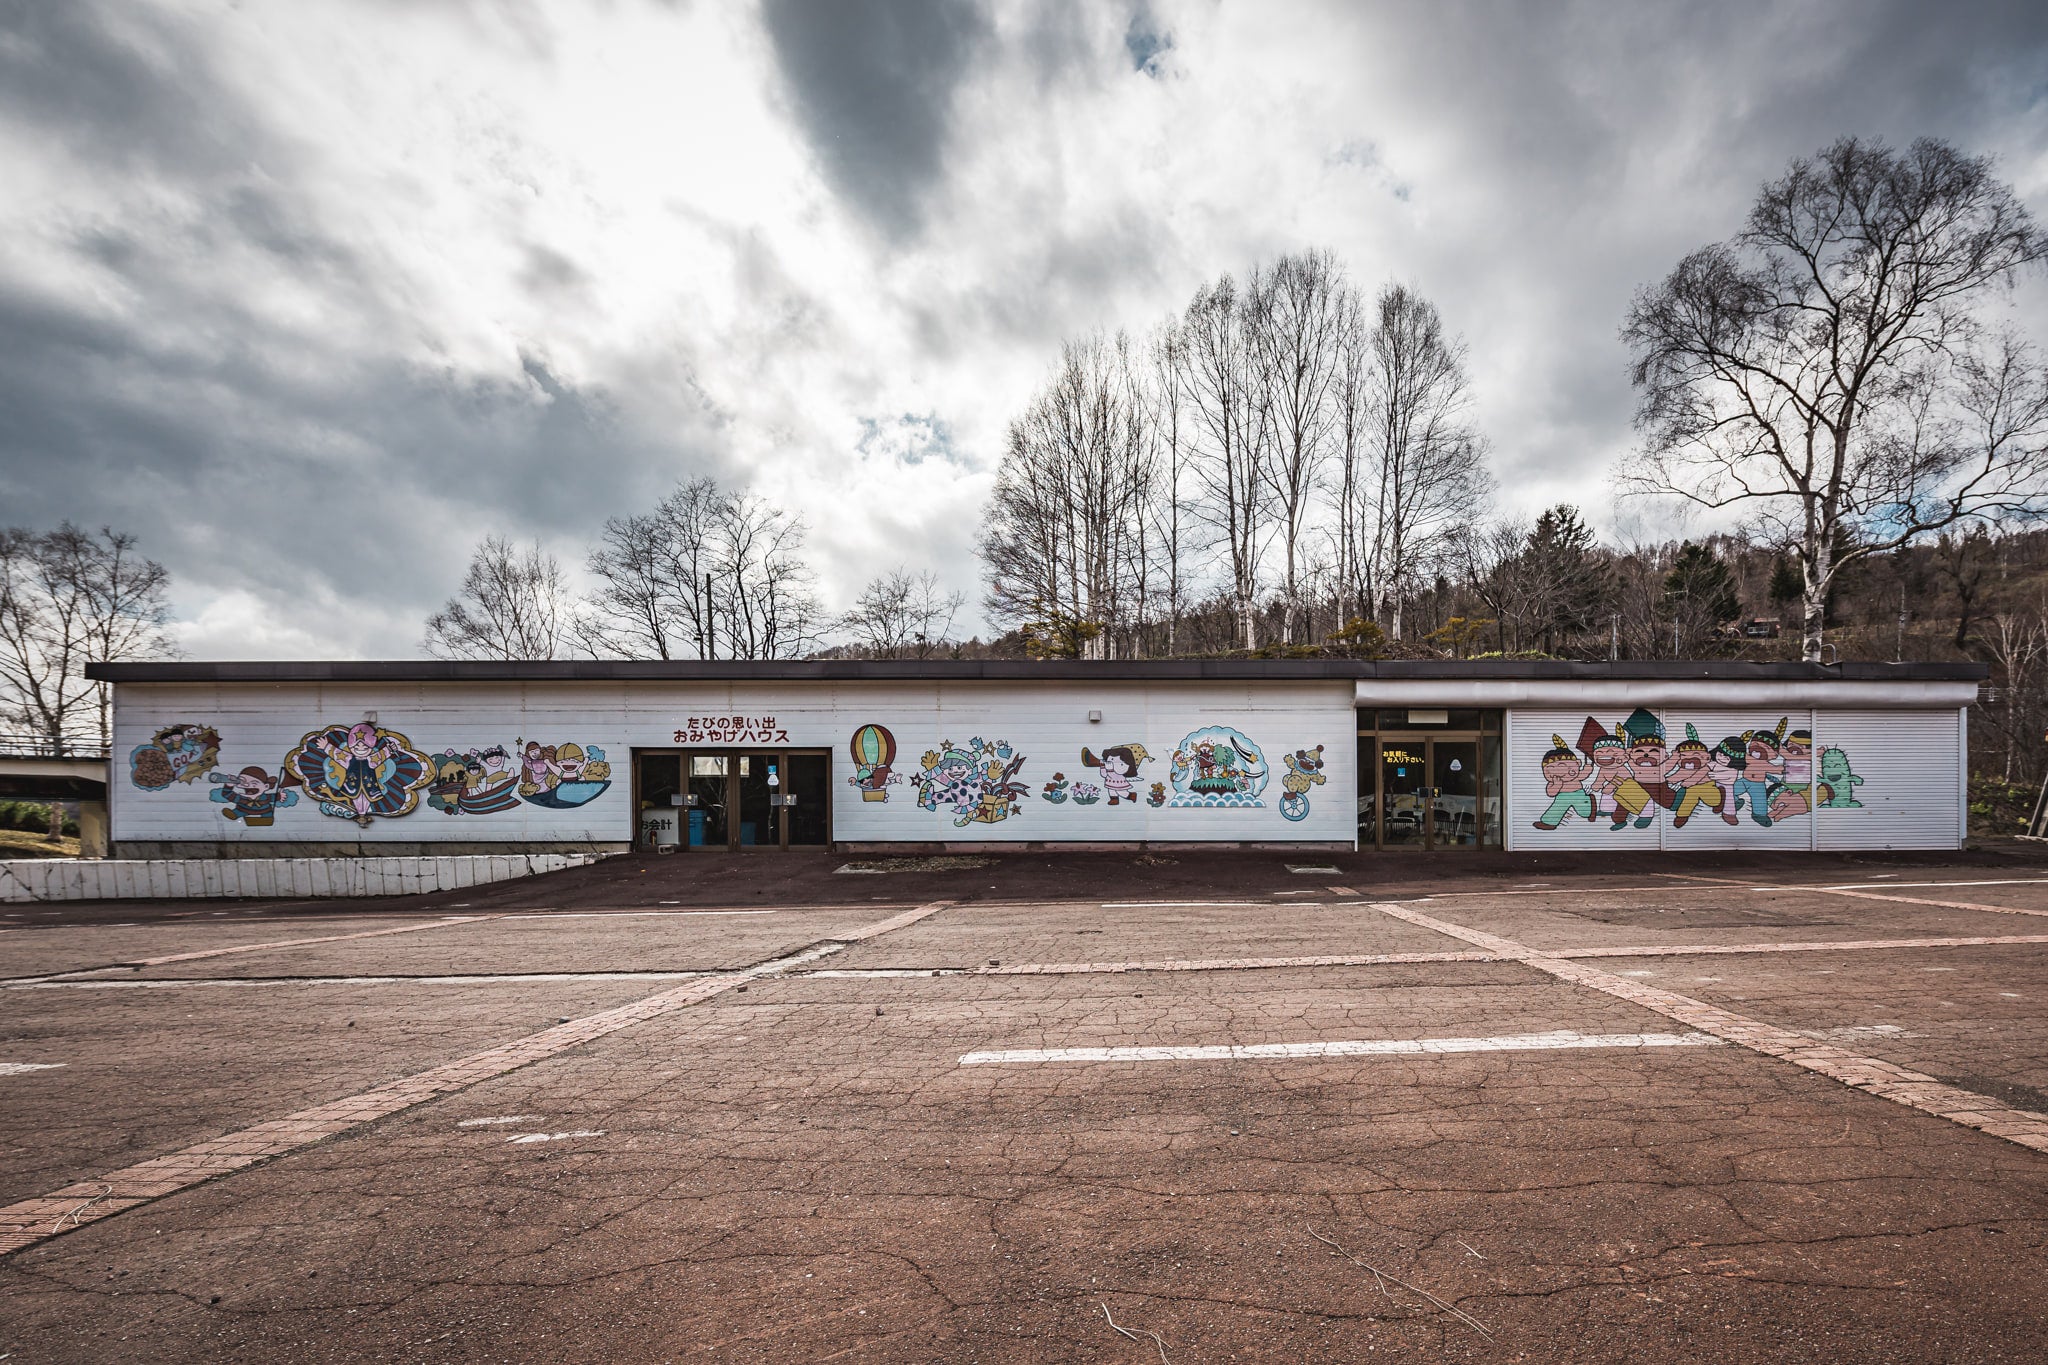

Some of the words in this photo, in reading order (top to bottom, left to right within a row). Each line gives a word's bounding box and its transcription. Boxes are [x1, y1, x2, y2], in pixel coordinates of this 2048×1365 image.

[687, 716, 776, 729] たびの思い出
[673, 729, 790, 743] おみやげハウス
